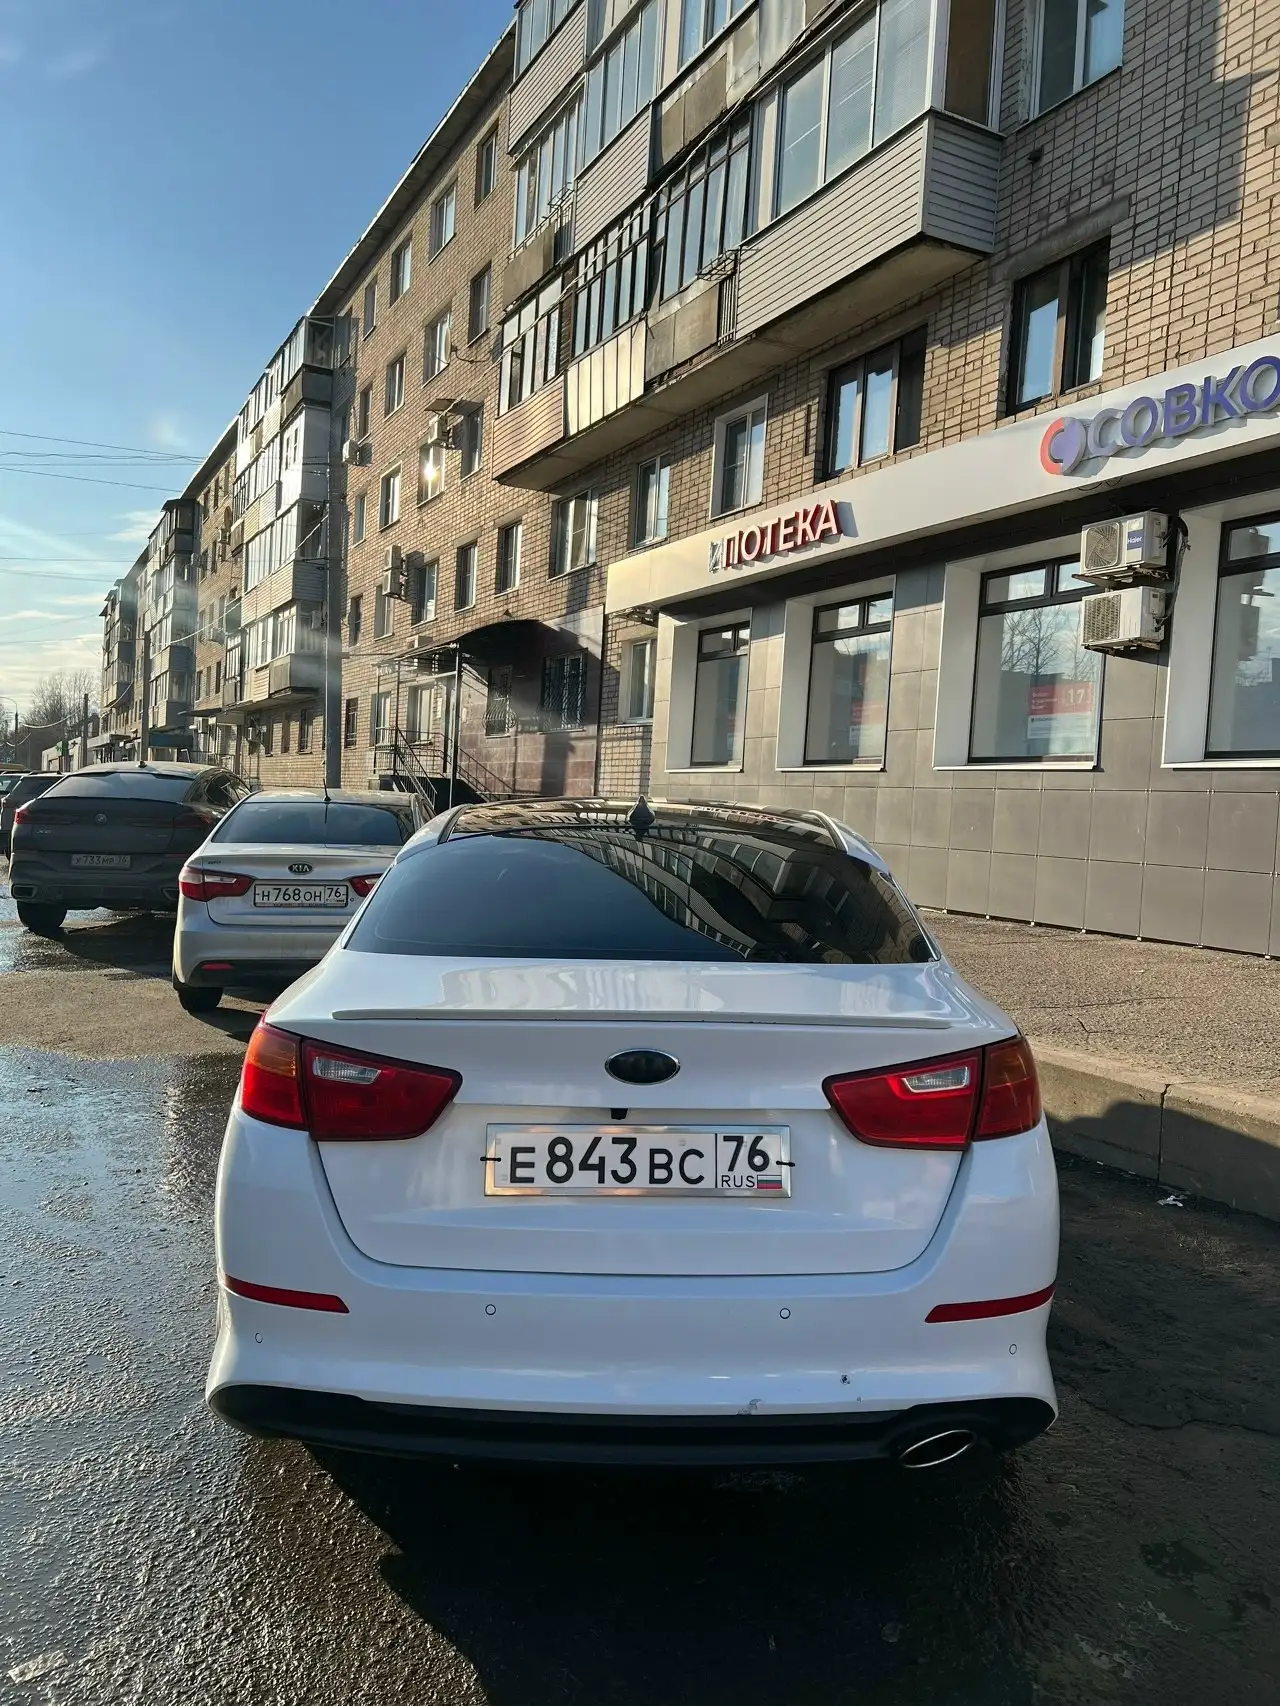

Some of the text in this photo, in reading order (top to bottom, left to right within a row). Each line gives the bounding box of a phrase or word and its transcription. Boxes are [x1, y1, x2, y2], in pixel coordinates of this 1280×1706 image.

[1088, 356, 1280, 456] СОВКО
[709, 500, 841, 572] ИПОТЕКА
[1128, 536, 1143, 545] Haier
[1067, 688, 1086, 704] 17
[292, 864, 310, 872] KIA
[261, 888, 322, 902] Н768ОН
[327, 887, 342, 898] 76
[509, 1135, 770, 1184] Е843ВС 76
[721, 1175, 755, 1188] RUS
